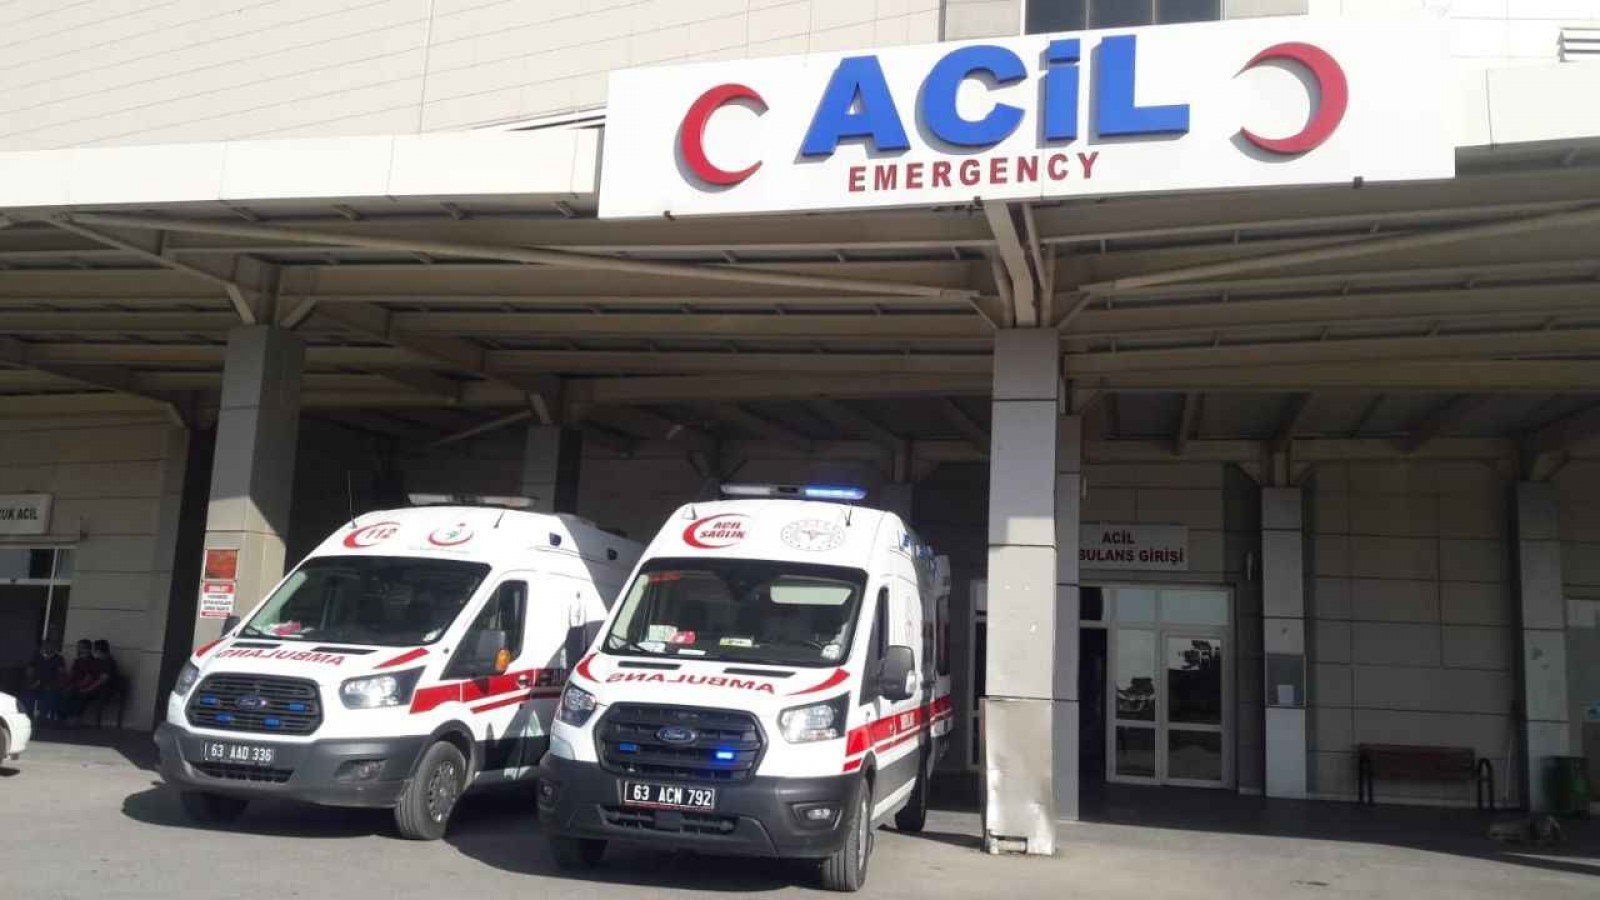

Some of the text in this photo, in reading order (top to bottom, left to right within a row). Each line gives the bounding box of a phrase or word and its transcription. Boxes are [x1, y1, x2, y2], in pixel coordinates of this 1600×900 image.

[847, 151, 1100, 193] EMERGENCY
[365, 527, 398, 539] 112
[664, 728, 686, 741] Ford
[211, 744, 224, 757] 63
[229, 746, 249, 760] AAD
[633, 784, 712, 806] 63 ACN 792
